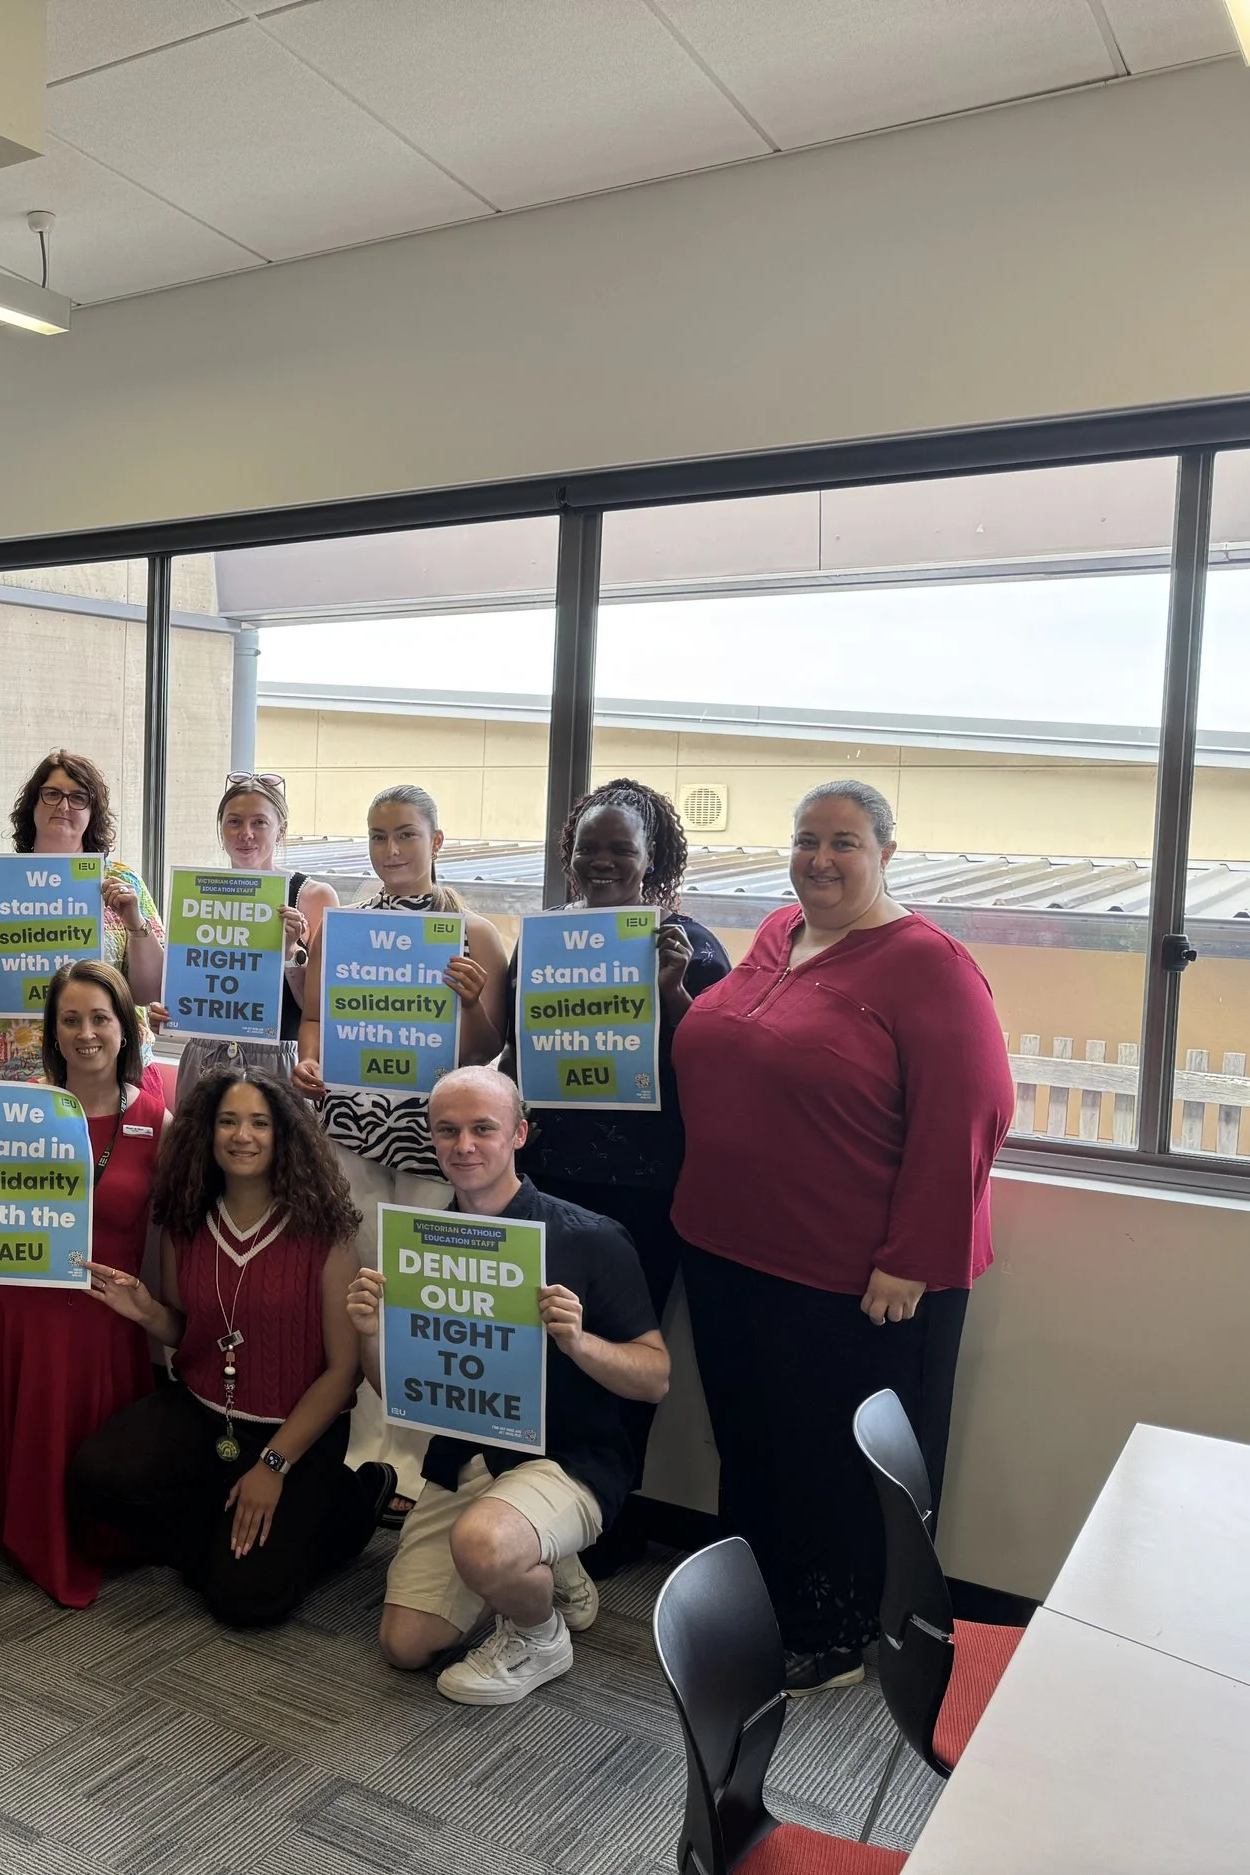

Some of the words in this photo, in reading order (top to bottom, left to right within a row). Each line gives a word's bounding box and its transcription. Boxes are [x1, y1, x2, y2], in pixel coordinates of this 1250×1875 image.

[78, 862, 96, 870] IEU
[26, 871, 62, 888] We
[0, 899, 62, 915] stand
[68, 897, 88, 914] in
[182, 899, 272, 922] DENIED
[434, 924, 454, 933] IEU
[626, 918, 648, 927] IEU
[0, 926, 92, 944] solidarity
[196, 925, 249, 946] OUR
[370, 930, 412, 950] We
[563, 930, 605, 950] We
[2, 953, 50, 972] with
[186, 948, 262, 971] RIGHT
[336, 962, 411, 982] stand
[418, 963, 442, 984] in
[530, 963, 606, 984] stand
[614, 960, 639, 982] in
[206, 974, 238, 994] TO
[178, 997, 264, 1022] STRIKE
[335, 994, 446, 1018] solidarity
[530, 995, 644, 1019] solidarity
[336, 1021, 392, 1044] with
[398, 1027, 442, 1048] the
[532, 1029, 590, 1051] with
[595, 1030, 640, 1051] the
[366, 1058, 410, 1074] AEU
[566, 1067, 610, 1086] AEU
[2, 1102, 44, 1124] We
[62, 1098, 77, 1108] IEU
[51, 1136, 74, 1159] in
[98, 1151, 110, 1167] IEU
[32, 1206, 76, 1228] the
[416, 1222, 460, 1234] VICTORIAN
[460, 1228, 502, 1238] CATHOLIC
[424, 1234, 470, 1246] EDUCATION
[471, 1240, 496, 1248] STAFF
[399, 1248, 524, 1288] DENIED
[420, 1285, 494, 1317] OUR
[410, 1314, 516, 1352] RIGHT
[438, 1350, 484, 1380] TO
[404, 1378, 521, 1421] STRIKE
[392, 1408, 406, 1416] IEU
